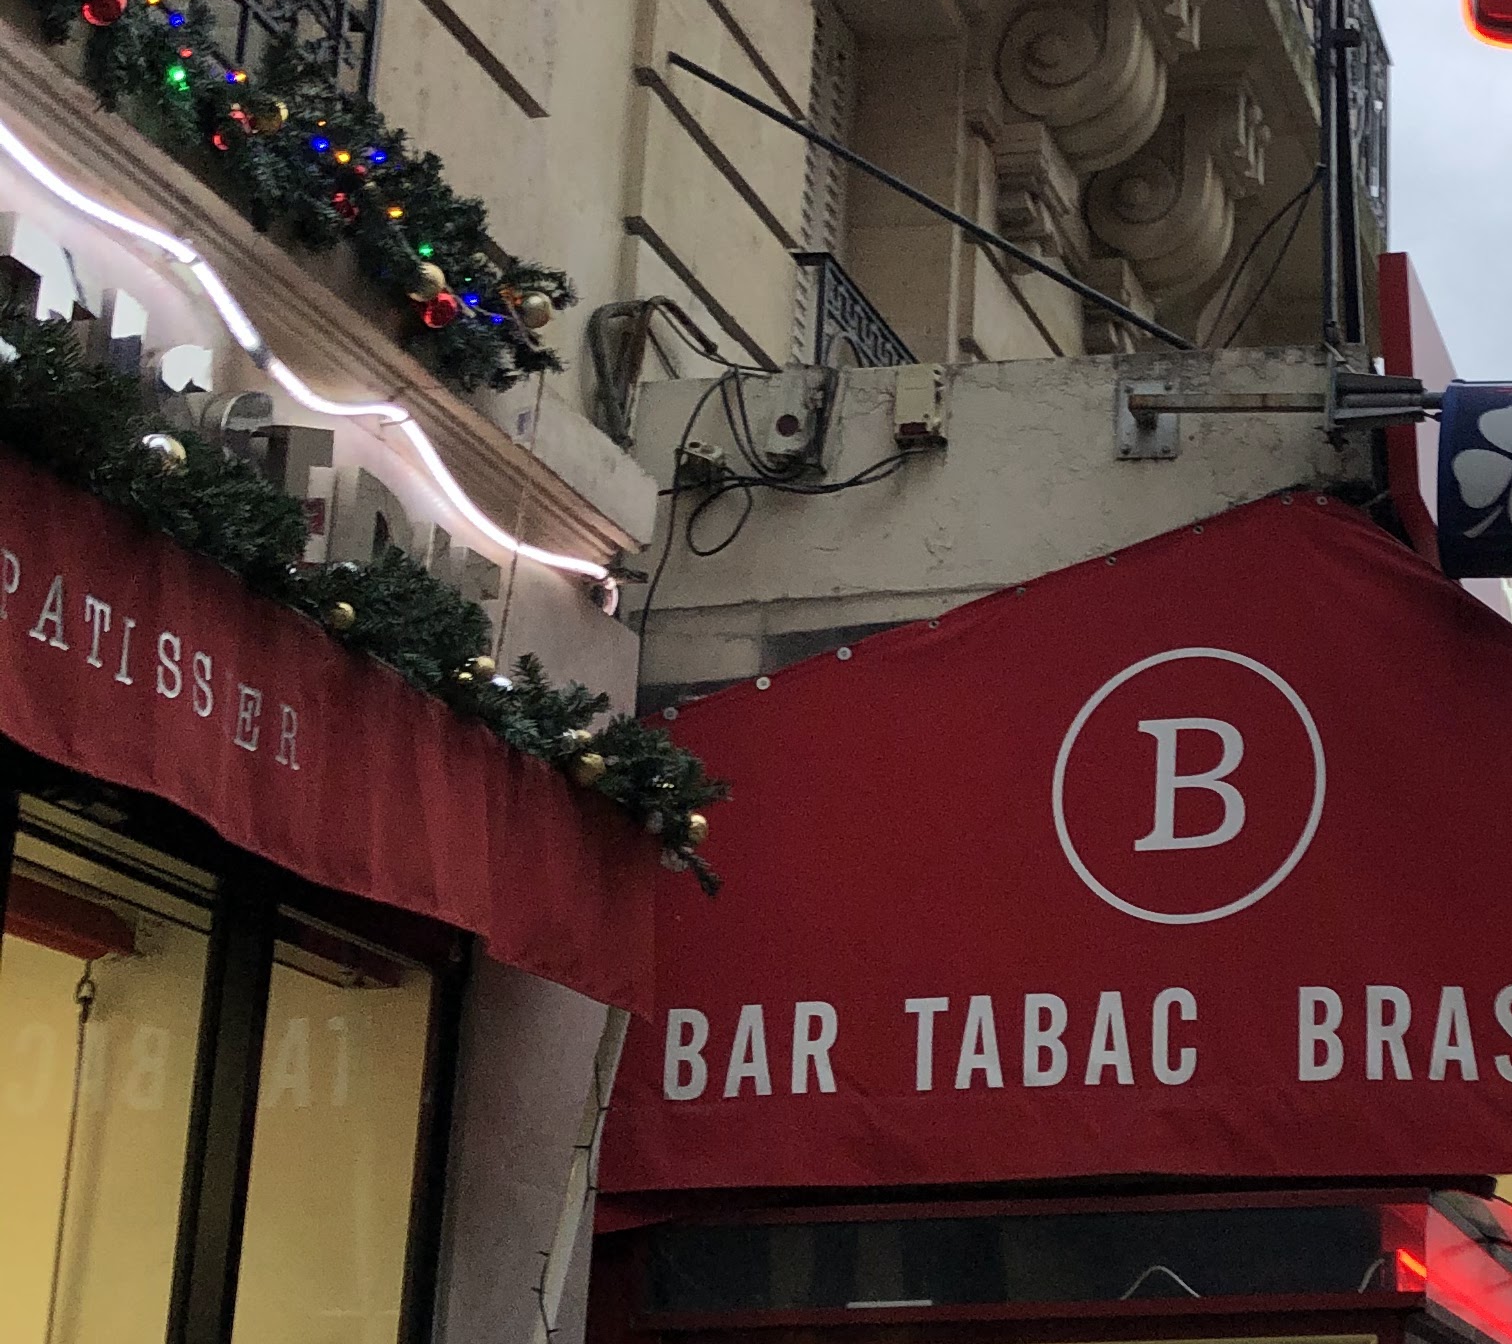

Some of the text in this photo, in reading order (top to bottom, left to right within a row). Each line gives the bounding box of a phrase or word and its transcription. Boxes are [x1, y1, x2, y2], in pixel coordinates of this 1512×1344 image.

[1134, 717, 1246, 852] B
[663, 1000, 839, 1101] BAR
[904, 986, 1198, 1091] TABAC
